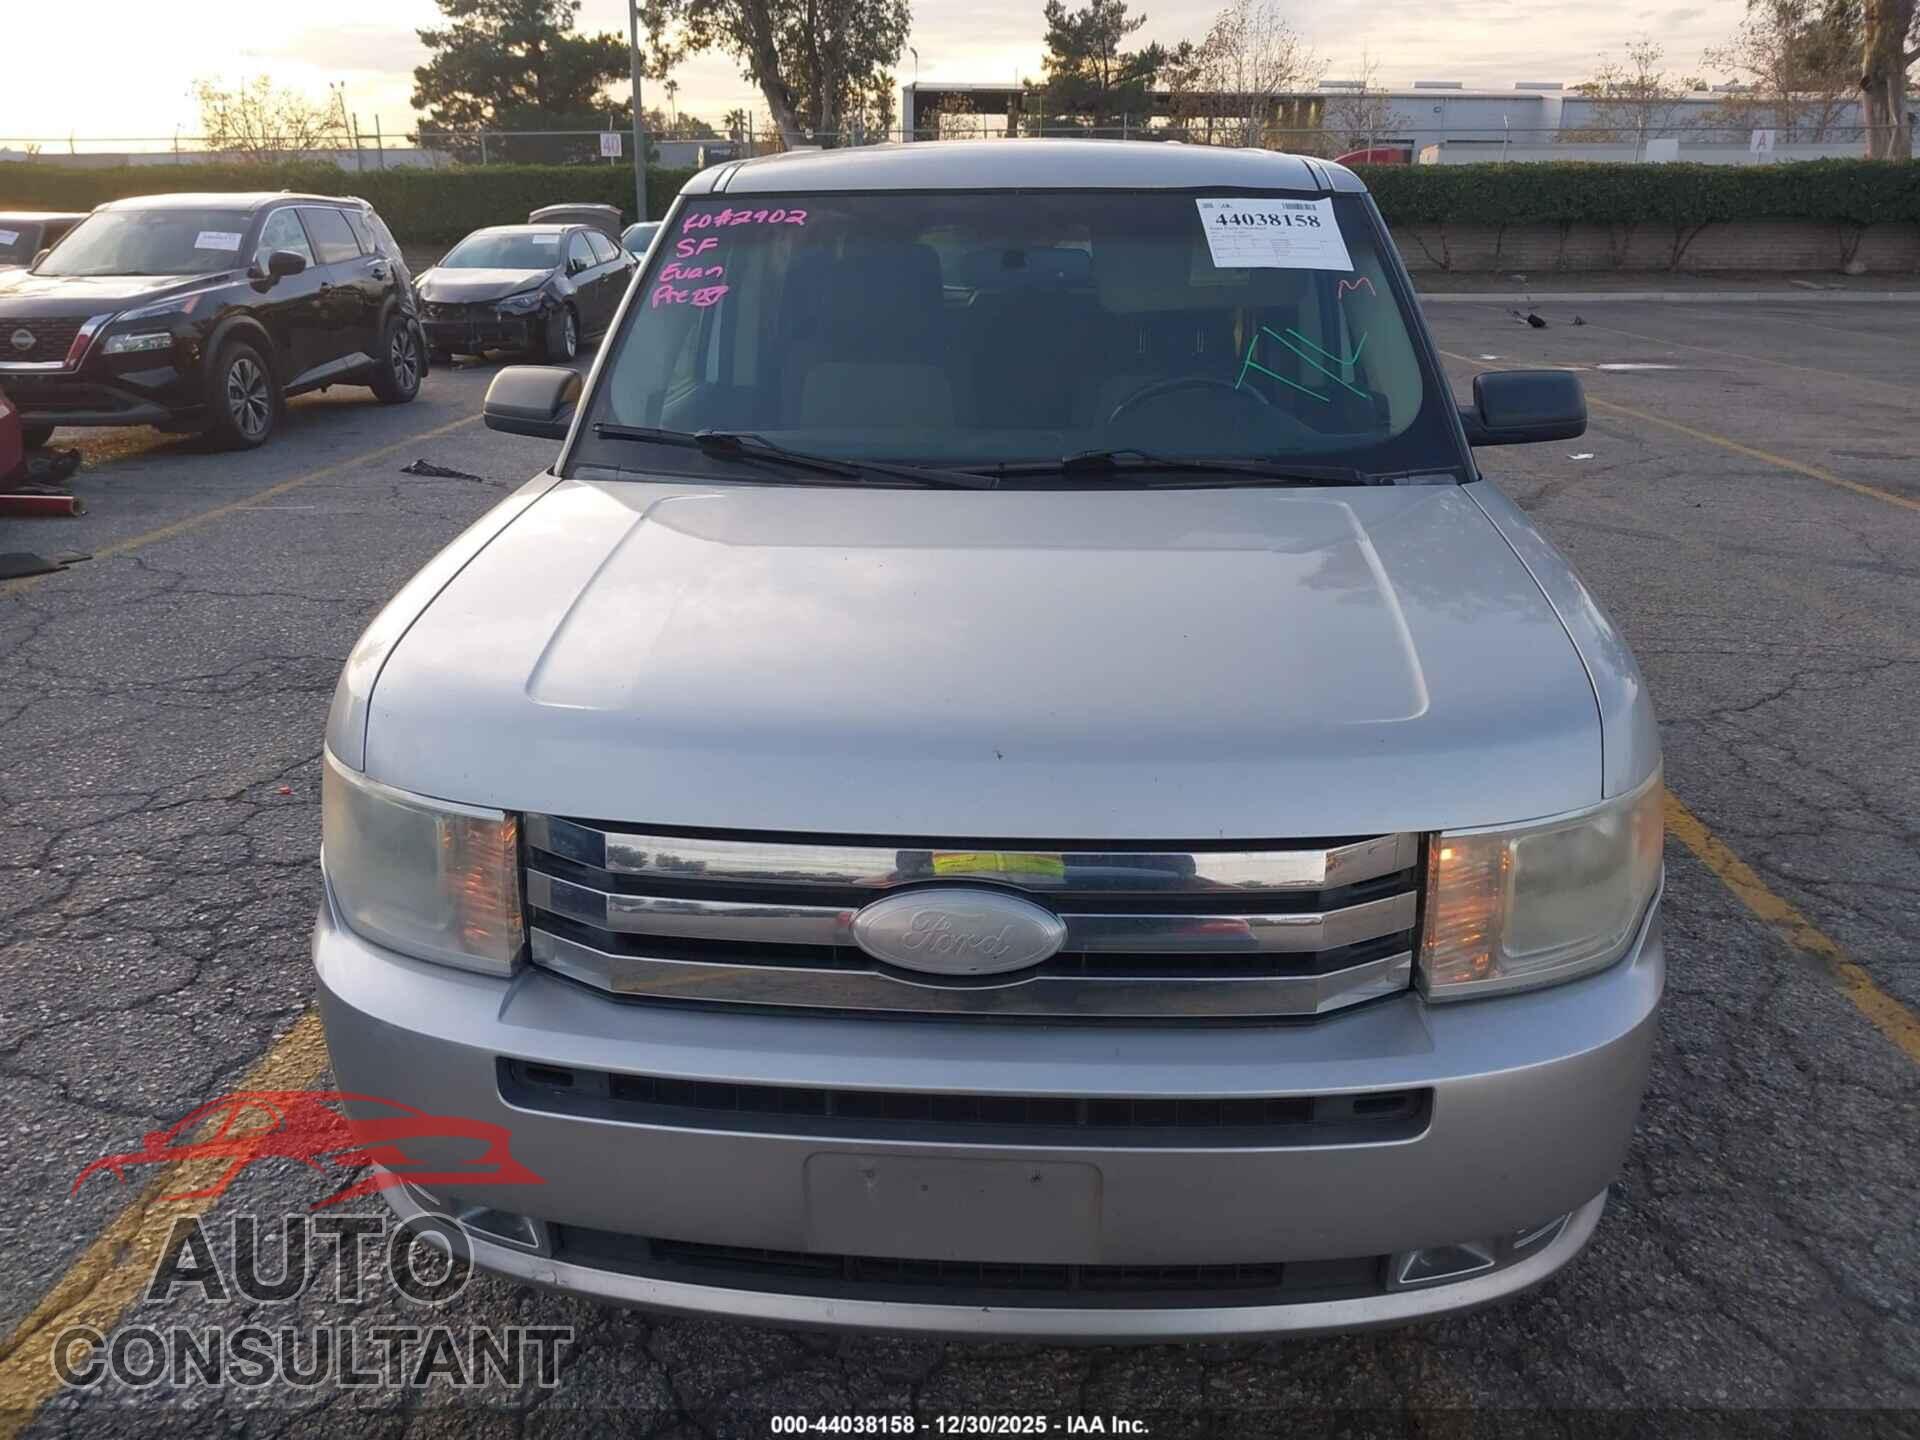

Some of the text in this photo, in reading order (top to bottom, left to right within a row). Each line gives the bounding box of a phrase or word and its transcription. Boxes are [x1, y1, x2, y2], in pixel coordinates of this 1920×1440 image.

[1215, 212, 1321, 228] 44038158
[676, 237, 718, 258] SF
[901, 911, 1011, 957] Ford
